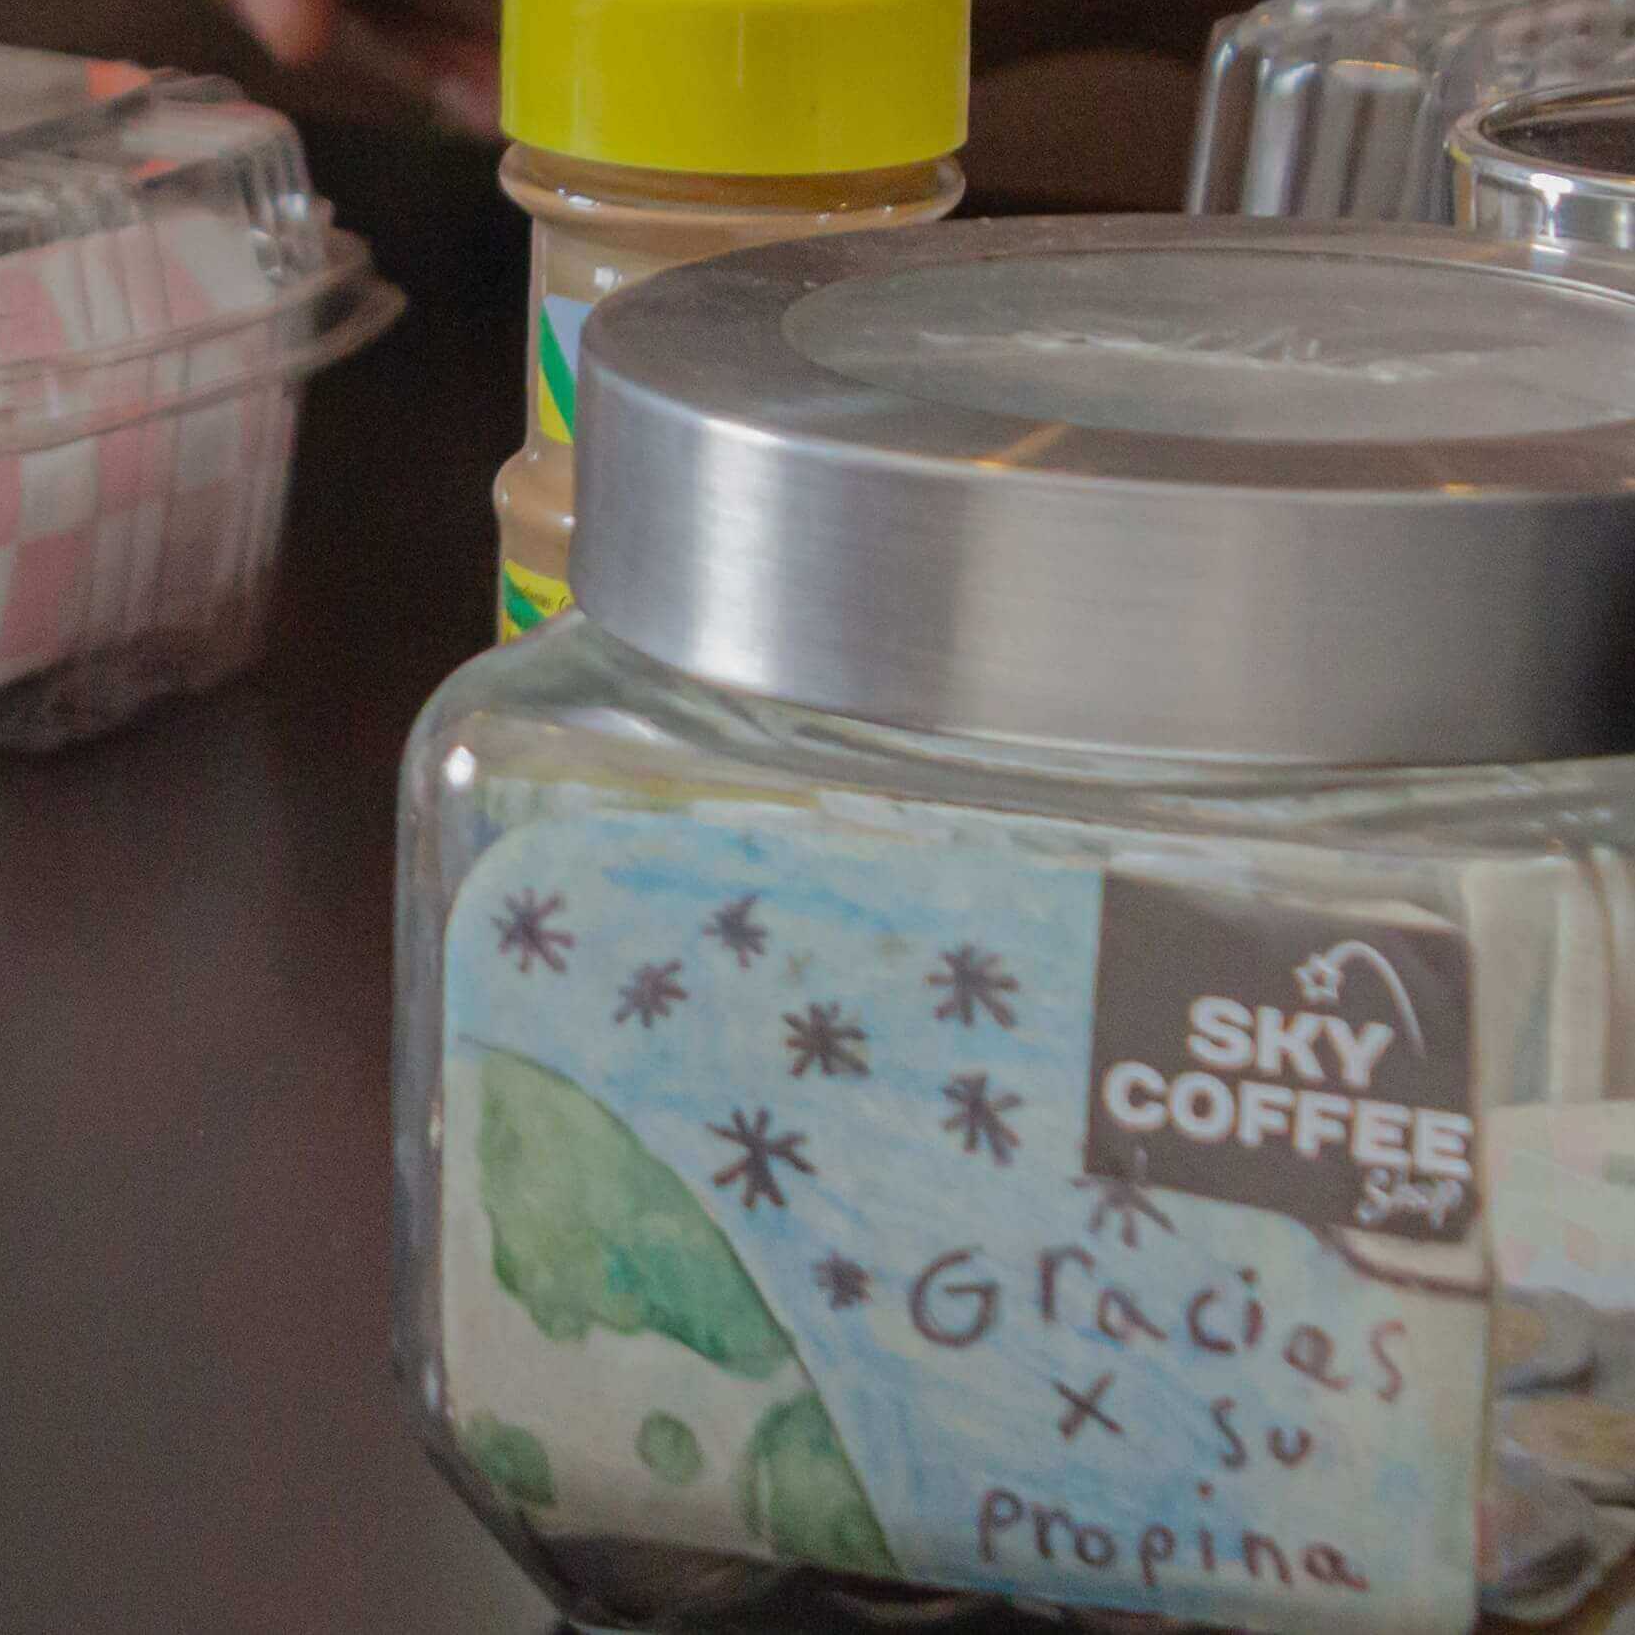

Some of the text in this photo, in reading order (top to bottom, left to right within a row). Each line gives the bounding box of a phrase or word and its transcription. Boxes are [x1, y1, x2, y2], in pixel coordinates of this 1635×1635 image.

[1187, 995, 1394, 1088] SKY
[1103, 1060, 1474, 1182] COFFEE
[909, 1244, 1406, 1403] Gracias
